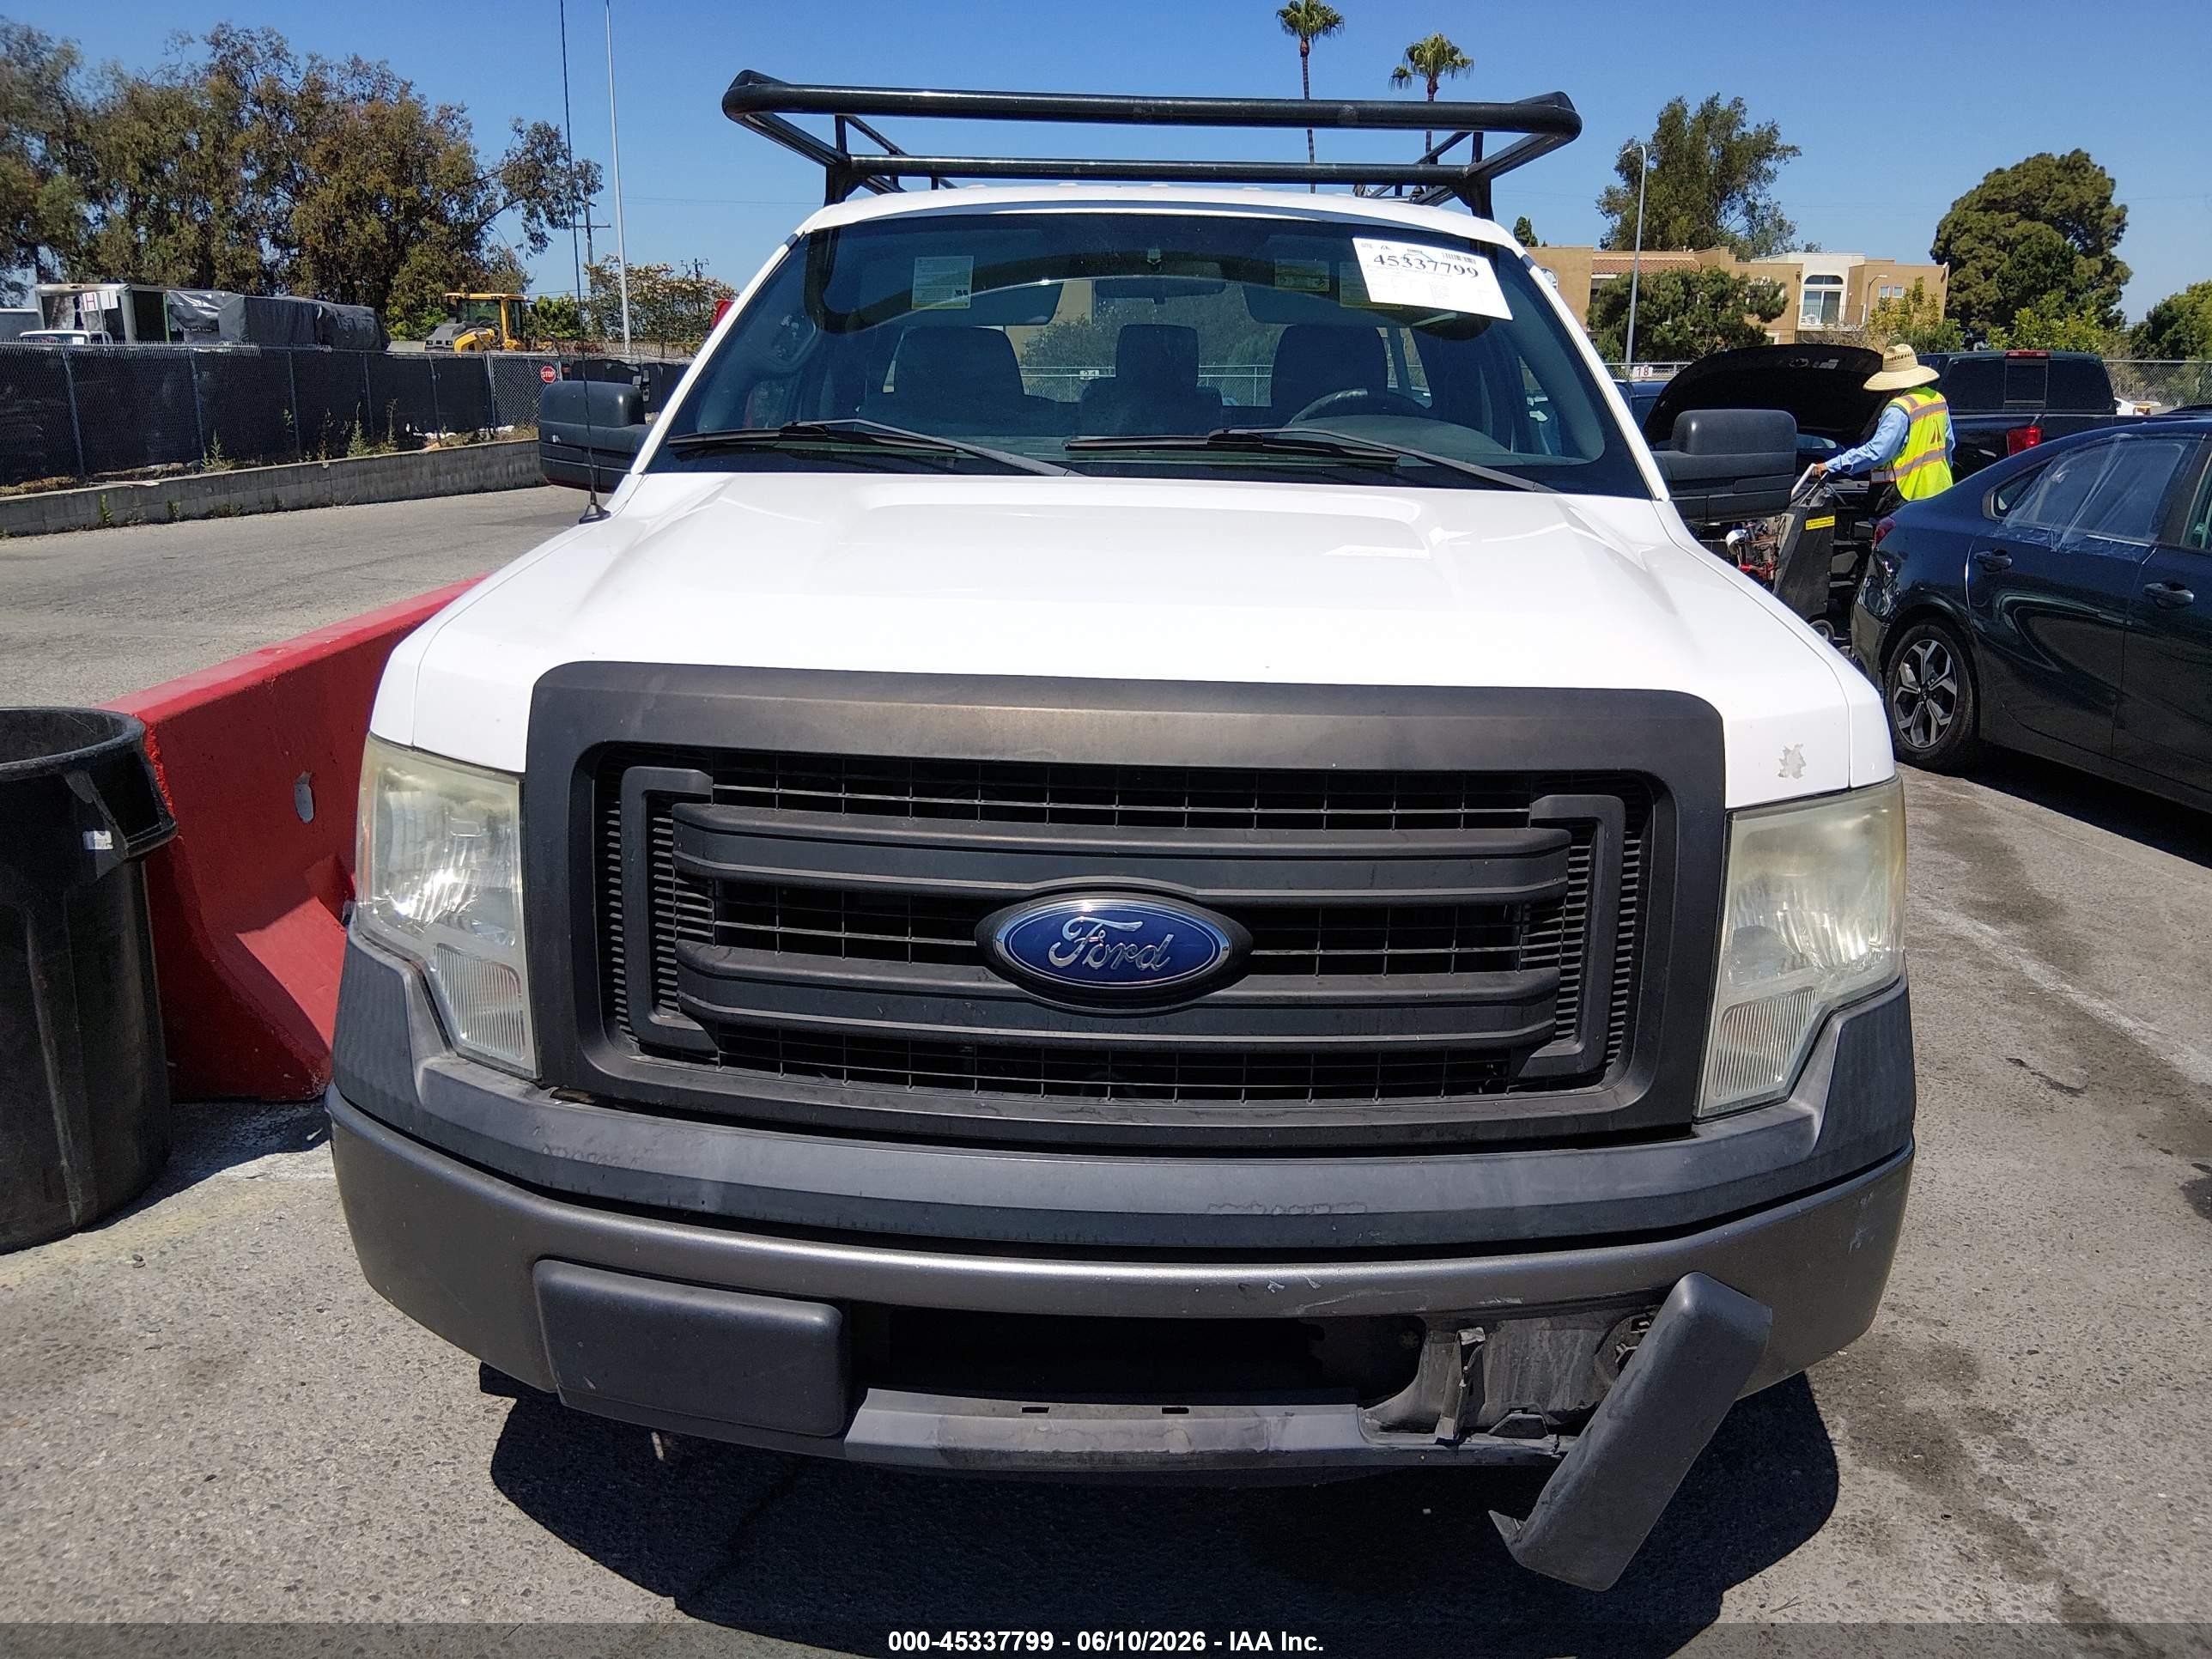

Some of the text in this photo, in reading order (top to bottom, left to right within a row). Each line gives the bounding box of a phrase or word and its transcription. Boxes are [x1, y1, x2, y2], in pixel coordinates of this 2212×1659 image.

[1373, 253, 1479, 278] 45337799
[85, 293, 96, 310] H
[1637, 367, 1650, 376] 18
[1048, 915, 1175, 971] Ford
